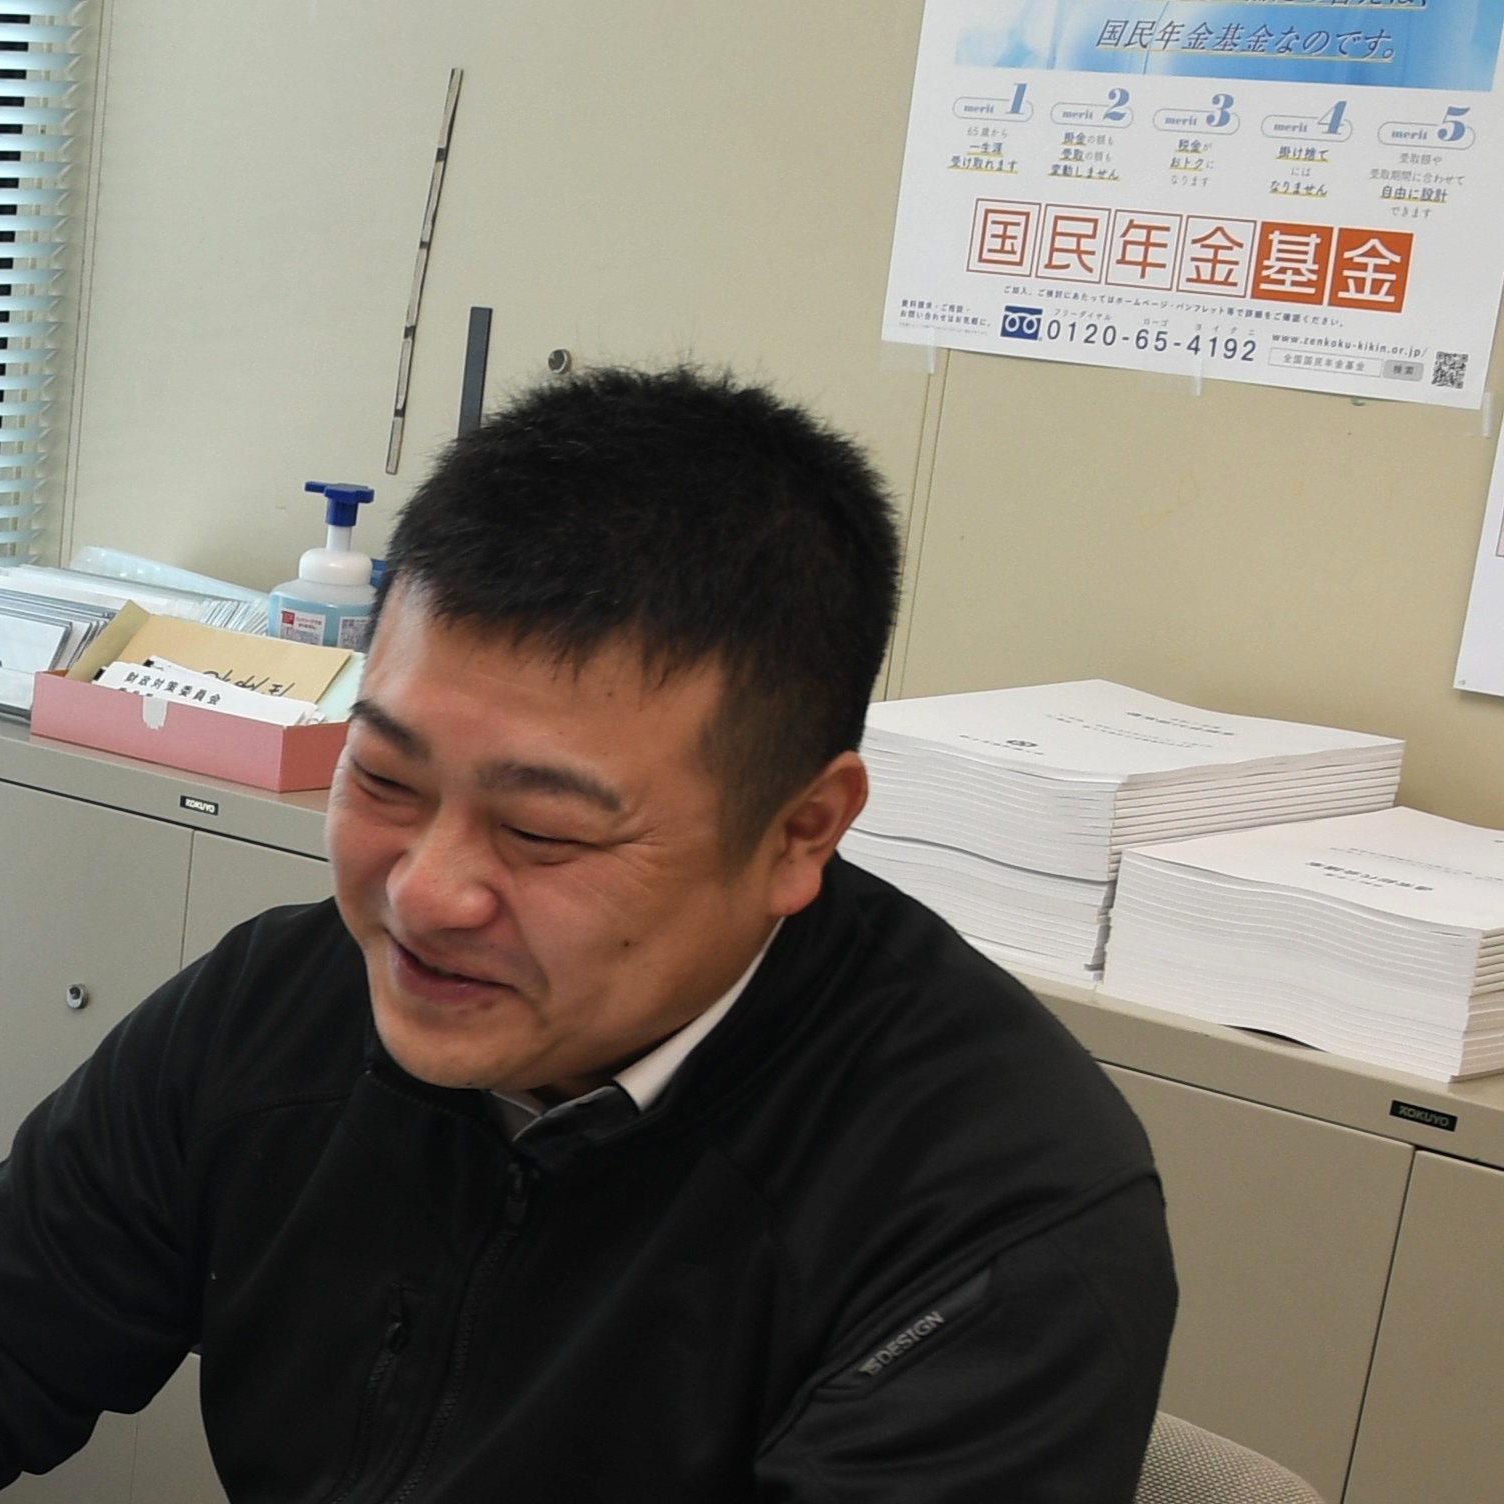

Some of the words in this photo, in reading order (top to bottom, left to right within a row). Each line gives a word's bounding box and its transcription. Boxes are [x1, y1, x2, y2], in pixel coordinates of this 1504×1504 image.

[1096, 19, 1396, 60] 国民年金基金なのです。
[963, 103, 994, 114] merit
[1005, 83, 1028, 115] 1
[1062, 108, 1093, 120] merit
[1103, 88, 1130, 121] 2
[1165, 115, 1197, 126] merit
[1206, 94, 1234, 127] 3
[1274, 122, 1307, 133] merit
[1318, 101, 1347, 135] 4
[1391, 129, 1427, 140] merit
[1438, 106, 1470, 142] 5
[1063, 132, 1115, 146] 掛金の額も
[1177, 139, 1212, 152] 税金が
[970, 142, 1003, 153] 一生涯
[1278, 146, 1329, 160] 掛け捨て
[951, 155, 1018, 171] 受け取れます
[1062, 149, 1112, 163] 受取の額も
[1170, 157, 1214, 170] おトクに
[1051, 164, 1119, 180] 変動しません
[1291, 167, 1310, 177] には
[1369, 168, 1465, 185] 受取期間に合わせて
[1171, 175, 1210, 187] なります
[1270, 181, 1327, 195] なりません
[1380, 185, 1448, 201] 自由に設計
[1392, 206, 1431, 219] できます
[971, 202, 1410, 308] 国民年金基金
[1047, 320, 1257, 362] 0120-65-4192
[1273, 334, 1428, 358] www.zenkoku-kikin.or.jp/
[1393, 365, 1414, 375] 検索
[124, 671, 221, 706] 財政対策委員会
[1399, 1105, 1449, 1127] KOKUYO
